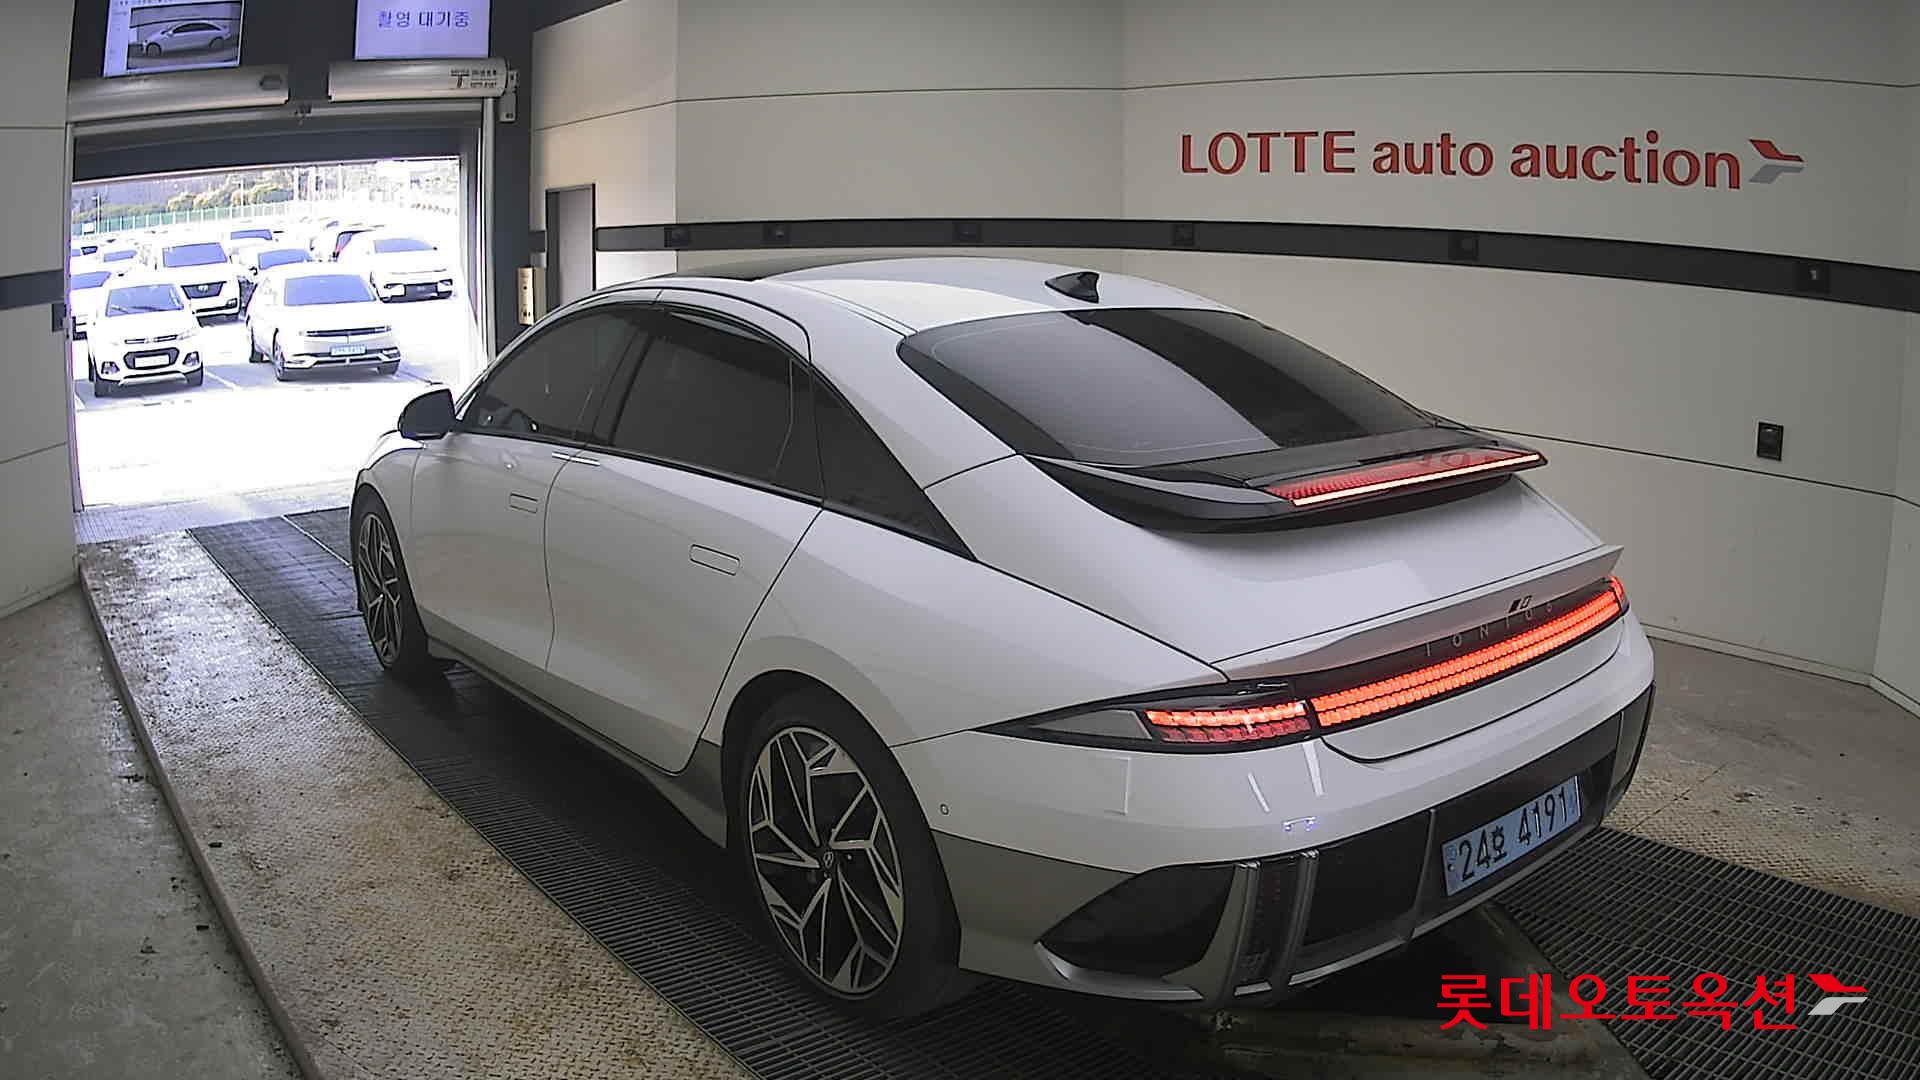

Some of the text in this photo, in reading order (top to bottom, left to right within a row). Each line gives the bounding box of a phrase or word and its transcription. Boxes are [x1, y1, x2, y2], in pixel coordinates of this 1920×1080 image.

[418, 10, 470, 28] 대기중
[1182, 130, 1741, 189] LOTTE auto auction
[1458, 785, 1568, 882] 24호 4191
